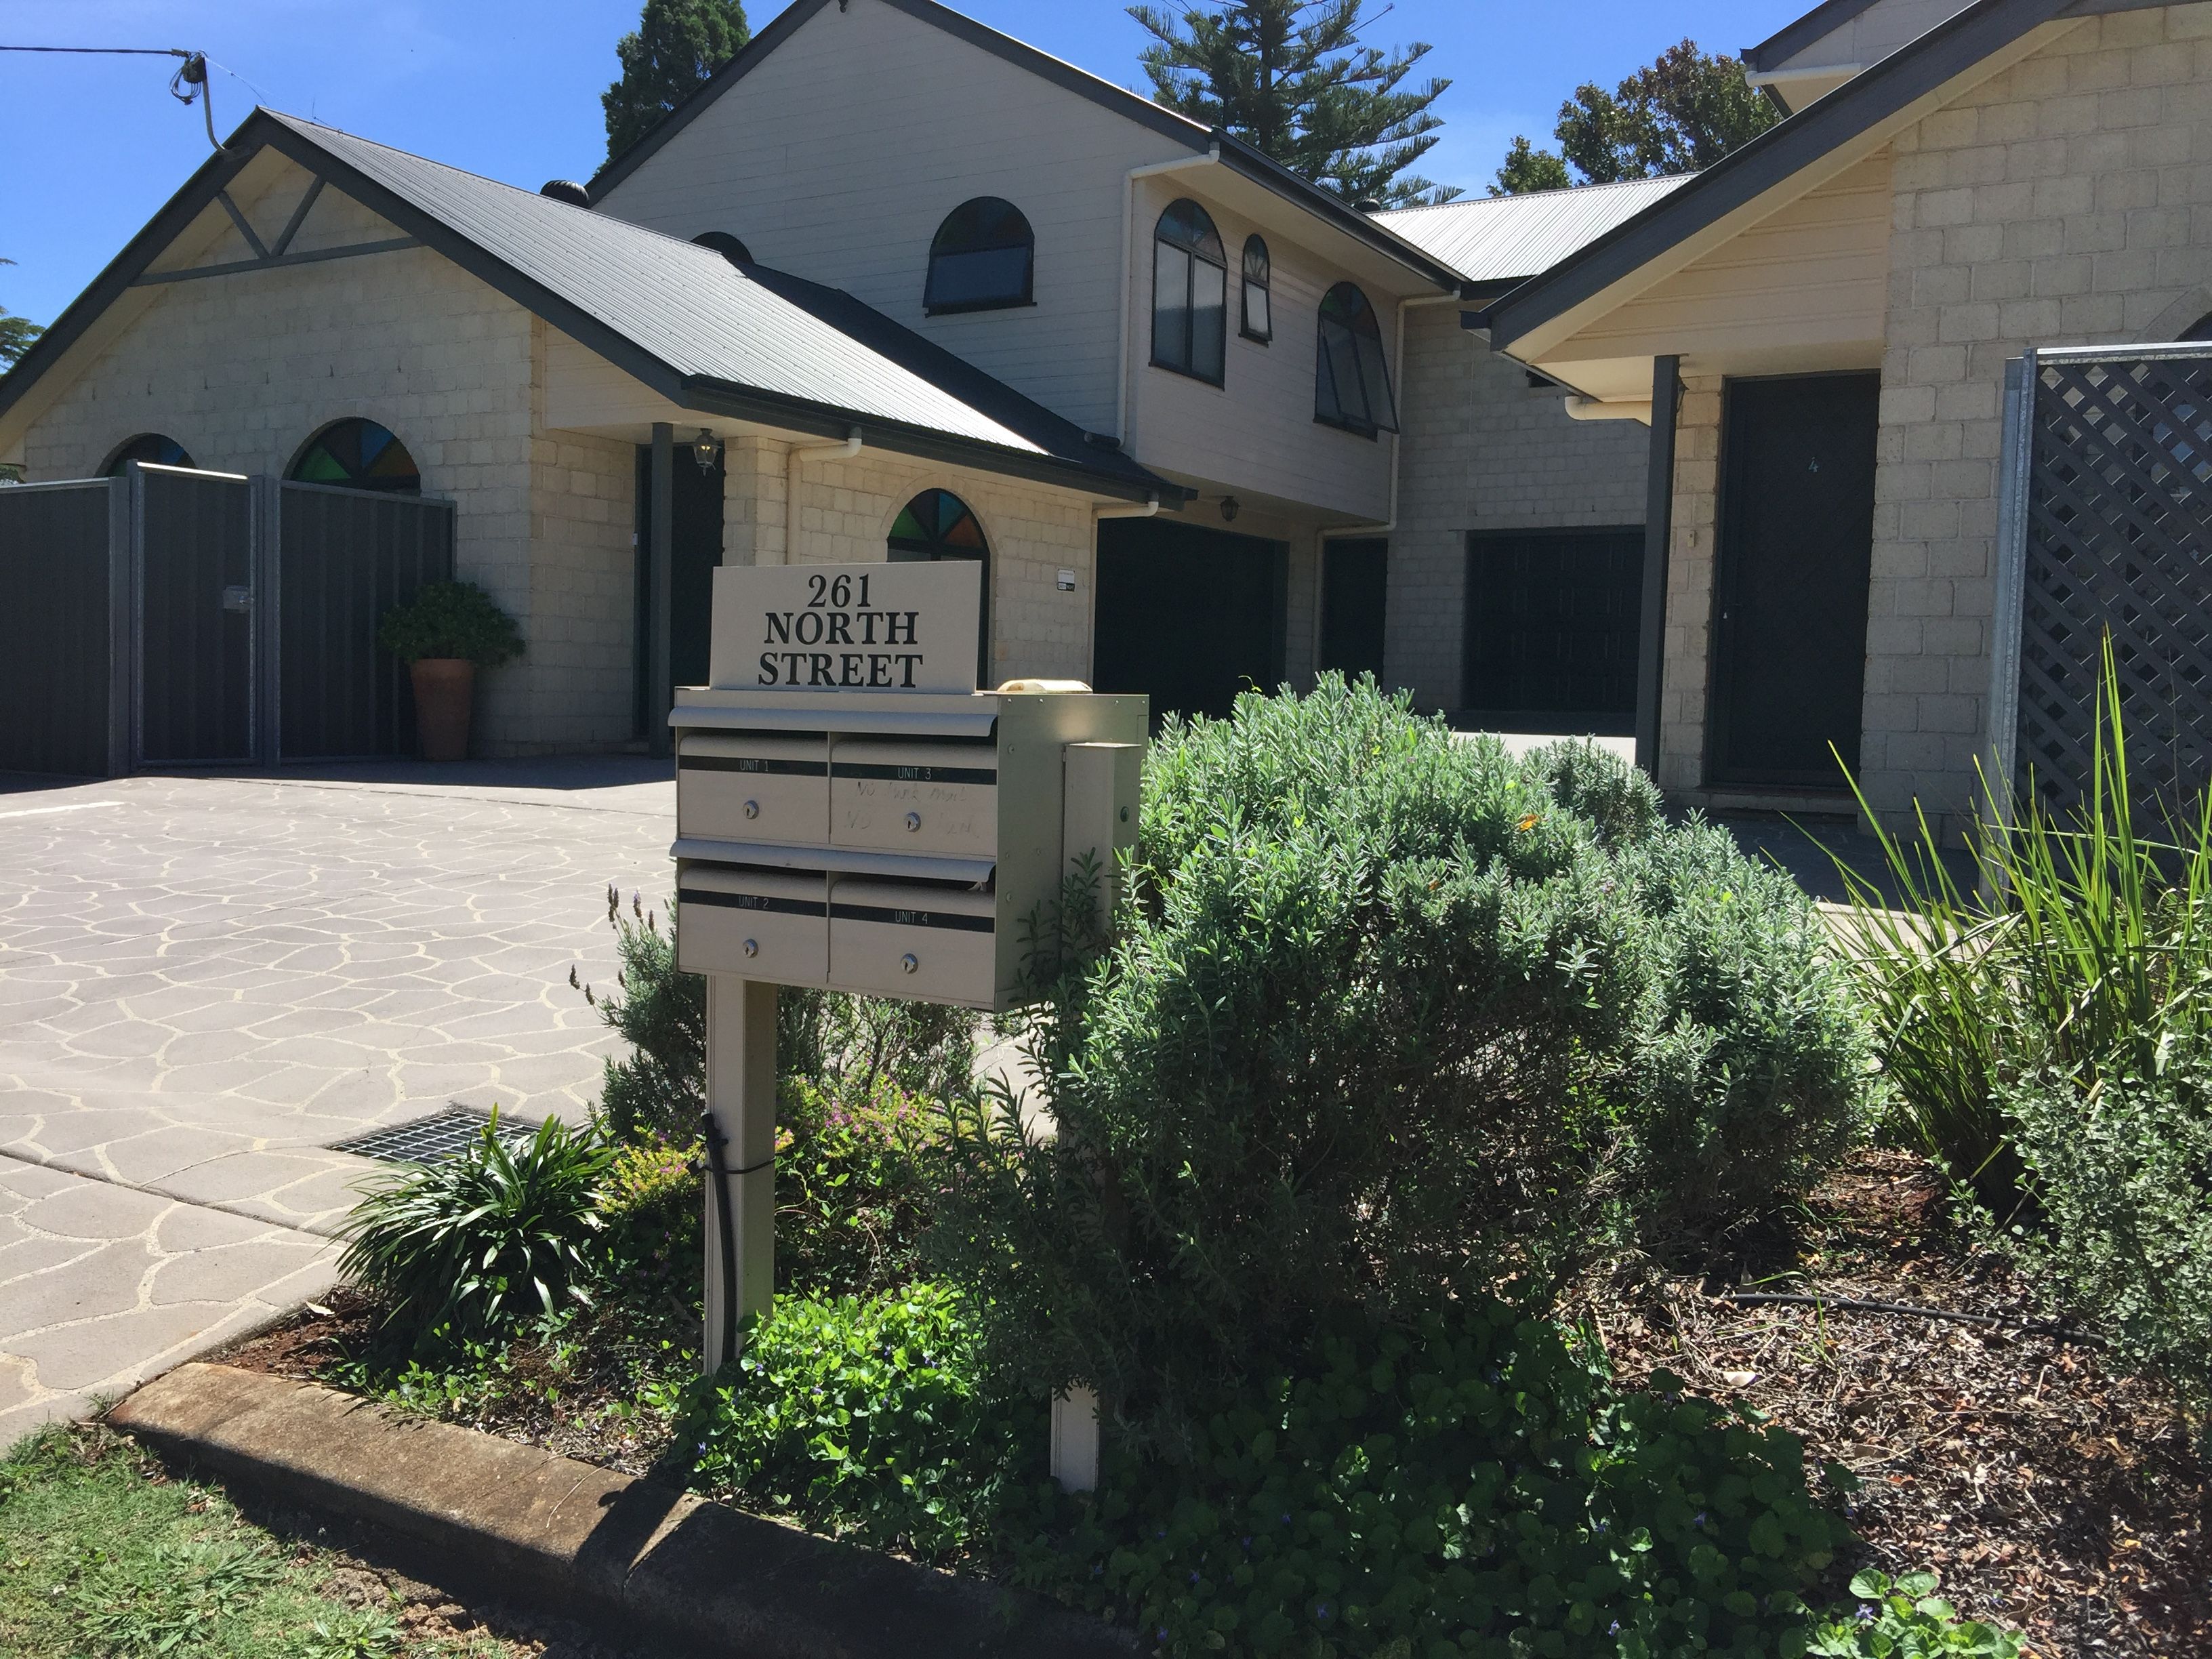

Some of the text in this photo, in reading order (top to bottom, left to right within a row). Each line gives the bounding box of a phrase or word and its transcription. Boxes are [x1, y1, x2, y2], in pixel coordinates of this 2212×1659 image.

[1808, 456, 1818, 472] 4
[807, 573, 872, 608] 261
[764, 611, 919, 645] NORTH
[758, 651, 923, 689] STREET
[739, 759, 769, 772] UNIT 1
[898, 766, 932, 780] UNIT 3
[738, 895, 769, 909] UNIT 2
[895, 910, 928, 924] UNIT 4
